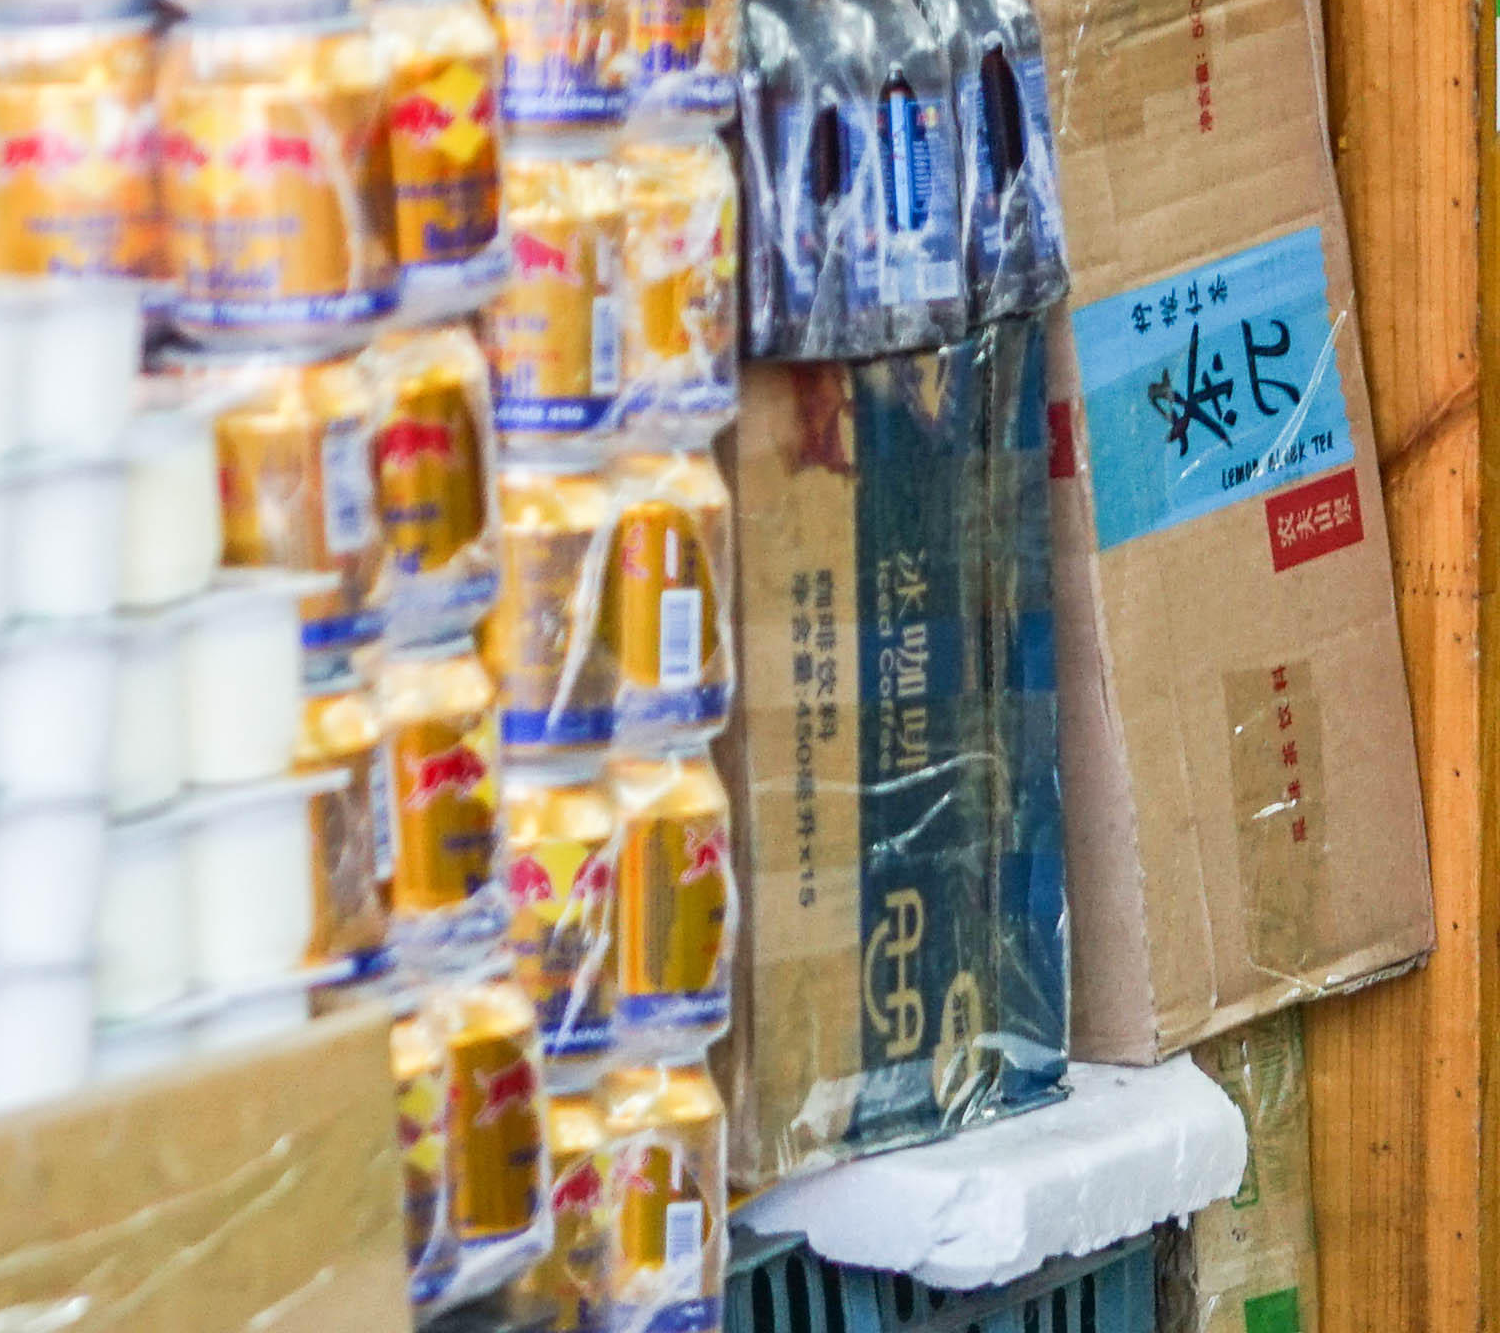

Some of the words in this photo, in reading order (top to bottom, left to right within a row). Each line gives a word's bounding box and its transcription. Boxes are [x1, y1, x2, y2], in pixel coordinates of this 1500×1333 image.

[1131, 274, 1228, 333] 柠檬红茶
[1310, 431, 1334, 454] TEA
[877, 560, 893, 637] Iced
[814, 568, 836, 743] 咖啡饮料
[897, 548, 930, 773] 冰咖啡
[879, 648, 893, 770] Coffee
